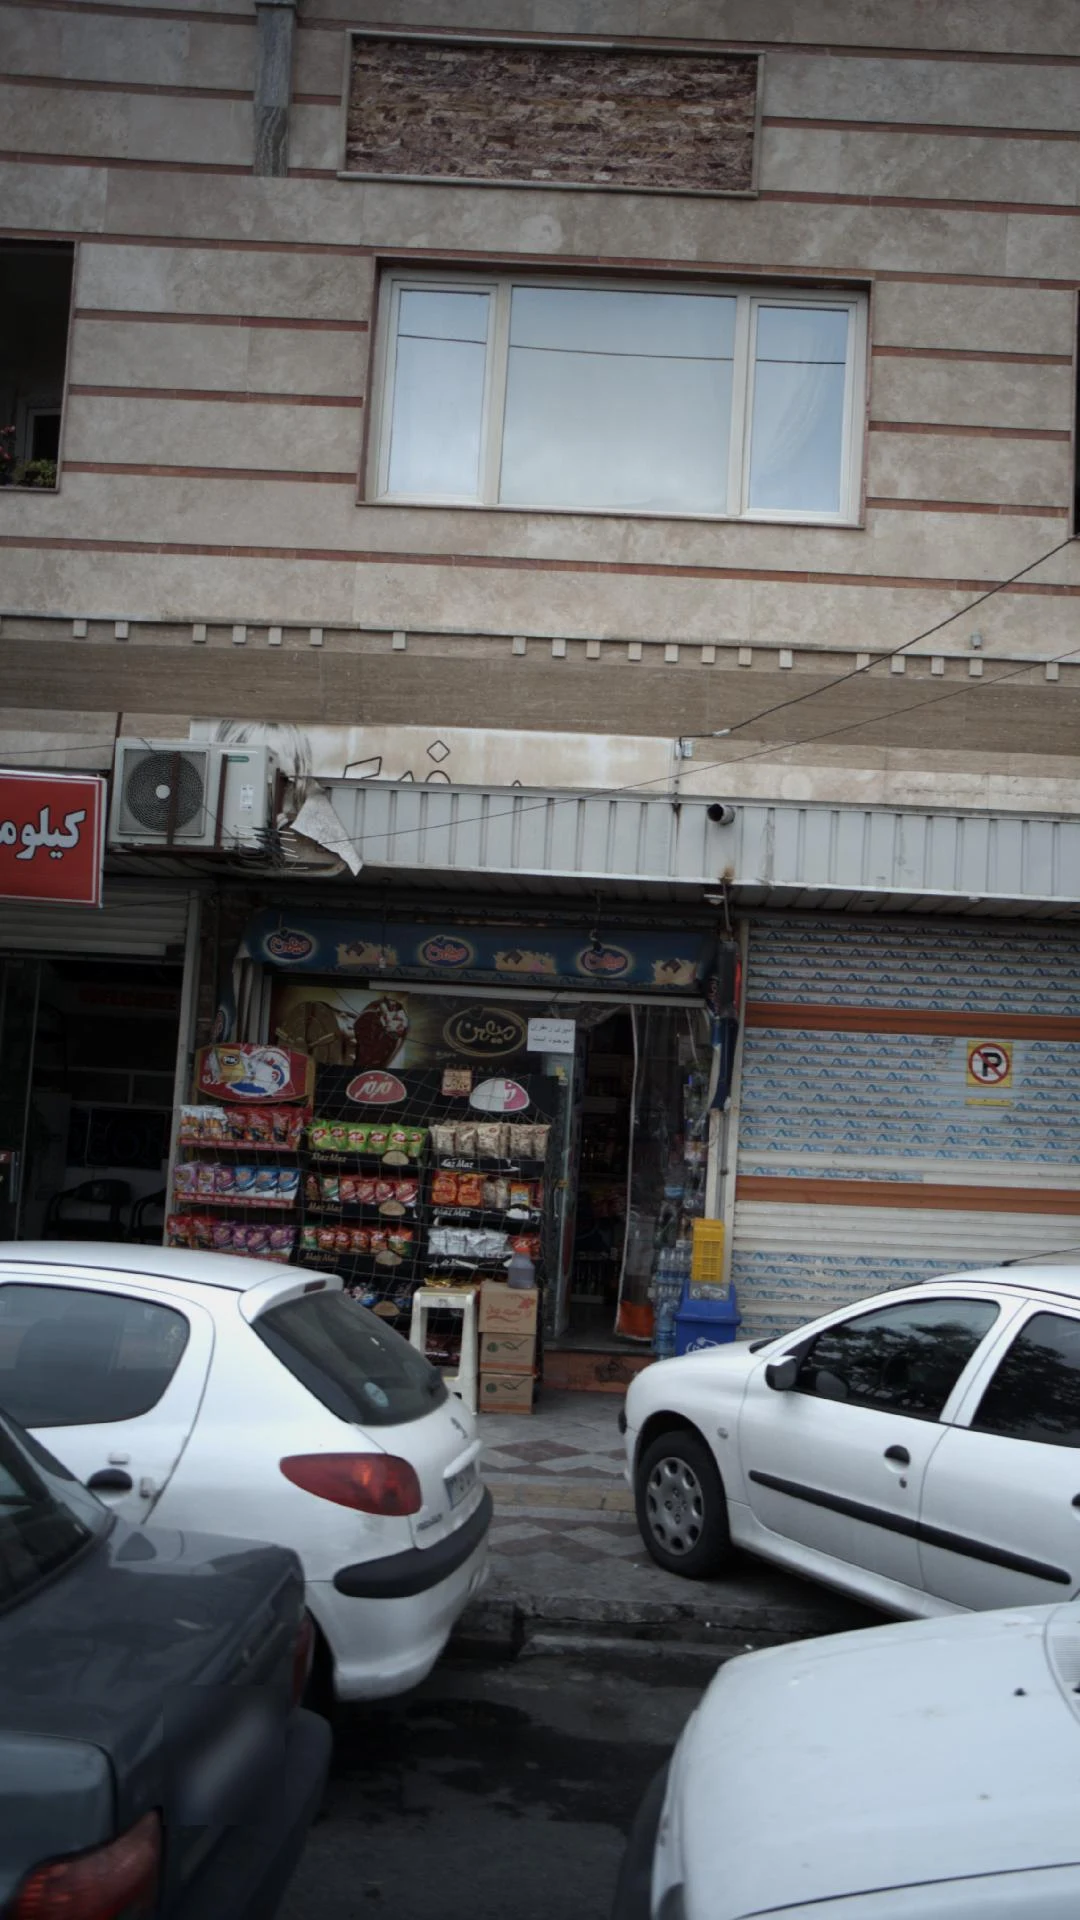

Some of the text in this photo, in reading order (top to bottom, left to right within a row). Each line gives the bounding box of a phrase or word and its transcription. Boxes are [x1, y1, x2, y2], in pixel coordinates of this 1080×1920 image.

[455, 1019, 516, 1045] میهن
[983, 1053, 1003, 1077] P
[354, 1075, 394, 1100] مزمز
[456, 1159, 474, 1168] Maz
